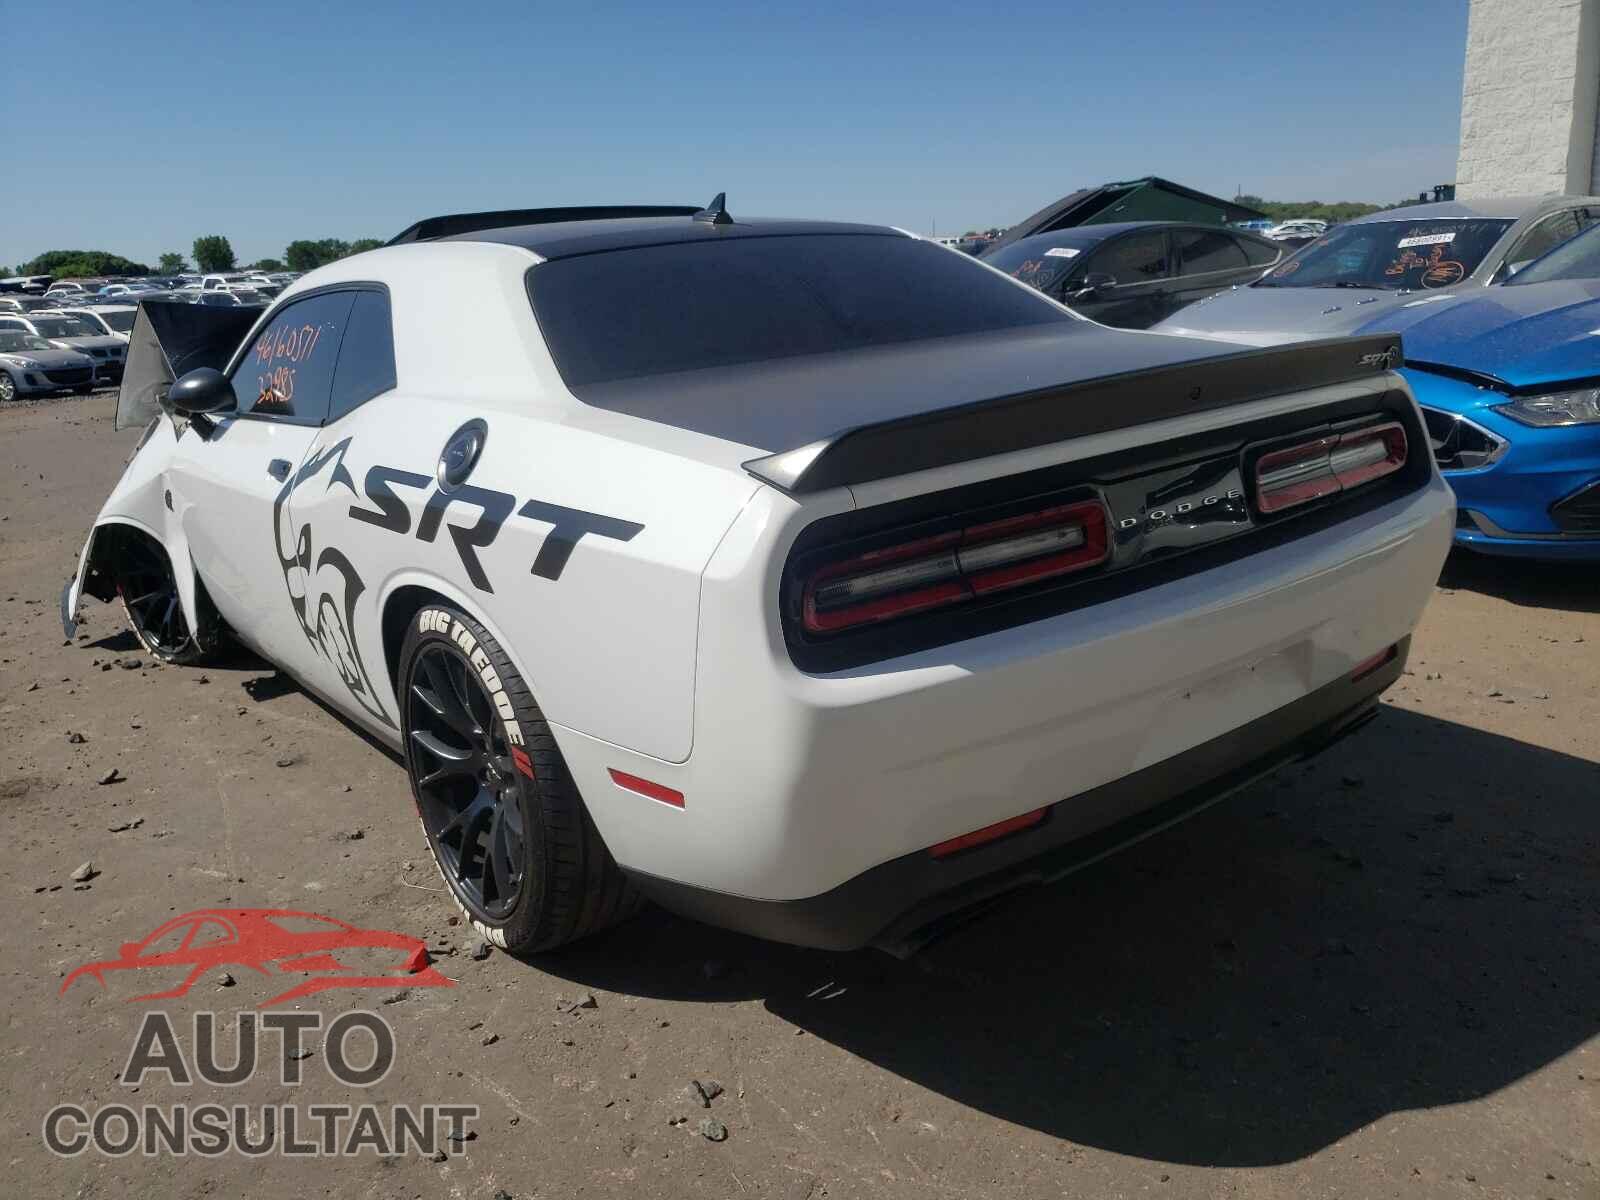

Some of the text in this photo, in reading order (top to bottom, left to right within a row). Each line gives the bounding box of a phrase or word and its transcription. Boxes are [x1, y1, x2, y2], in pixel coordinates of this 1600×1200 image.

[1359, 352, 1391, 366] SRT
[1120, 488, 1241, 528] DODGE
[349, 465, 645, 594] SRT
[419, 610, 451, 633] BIG
